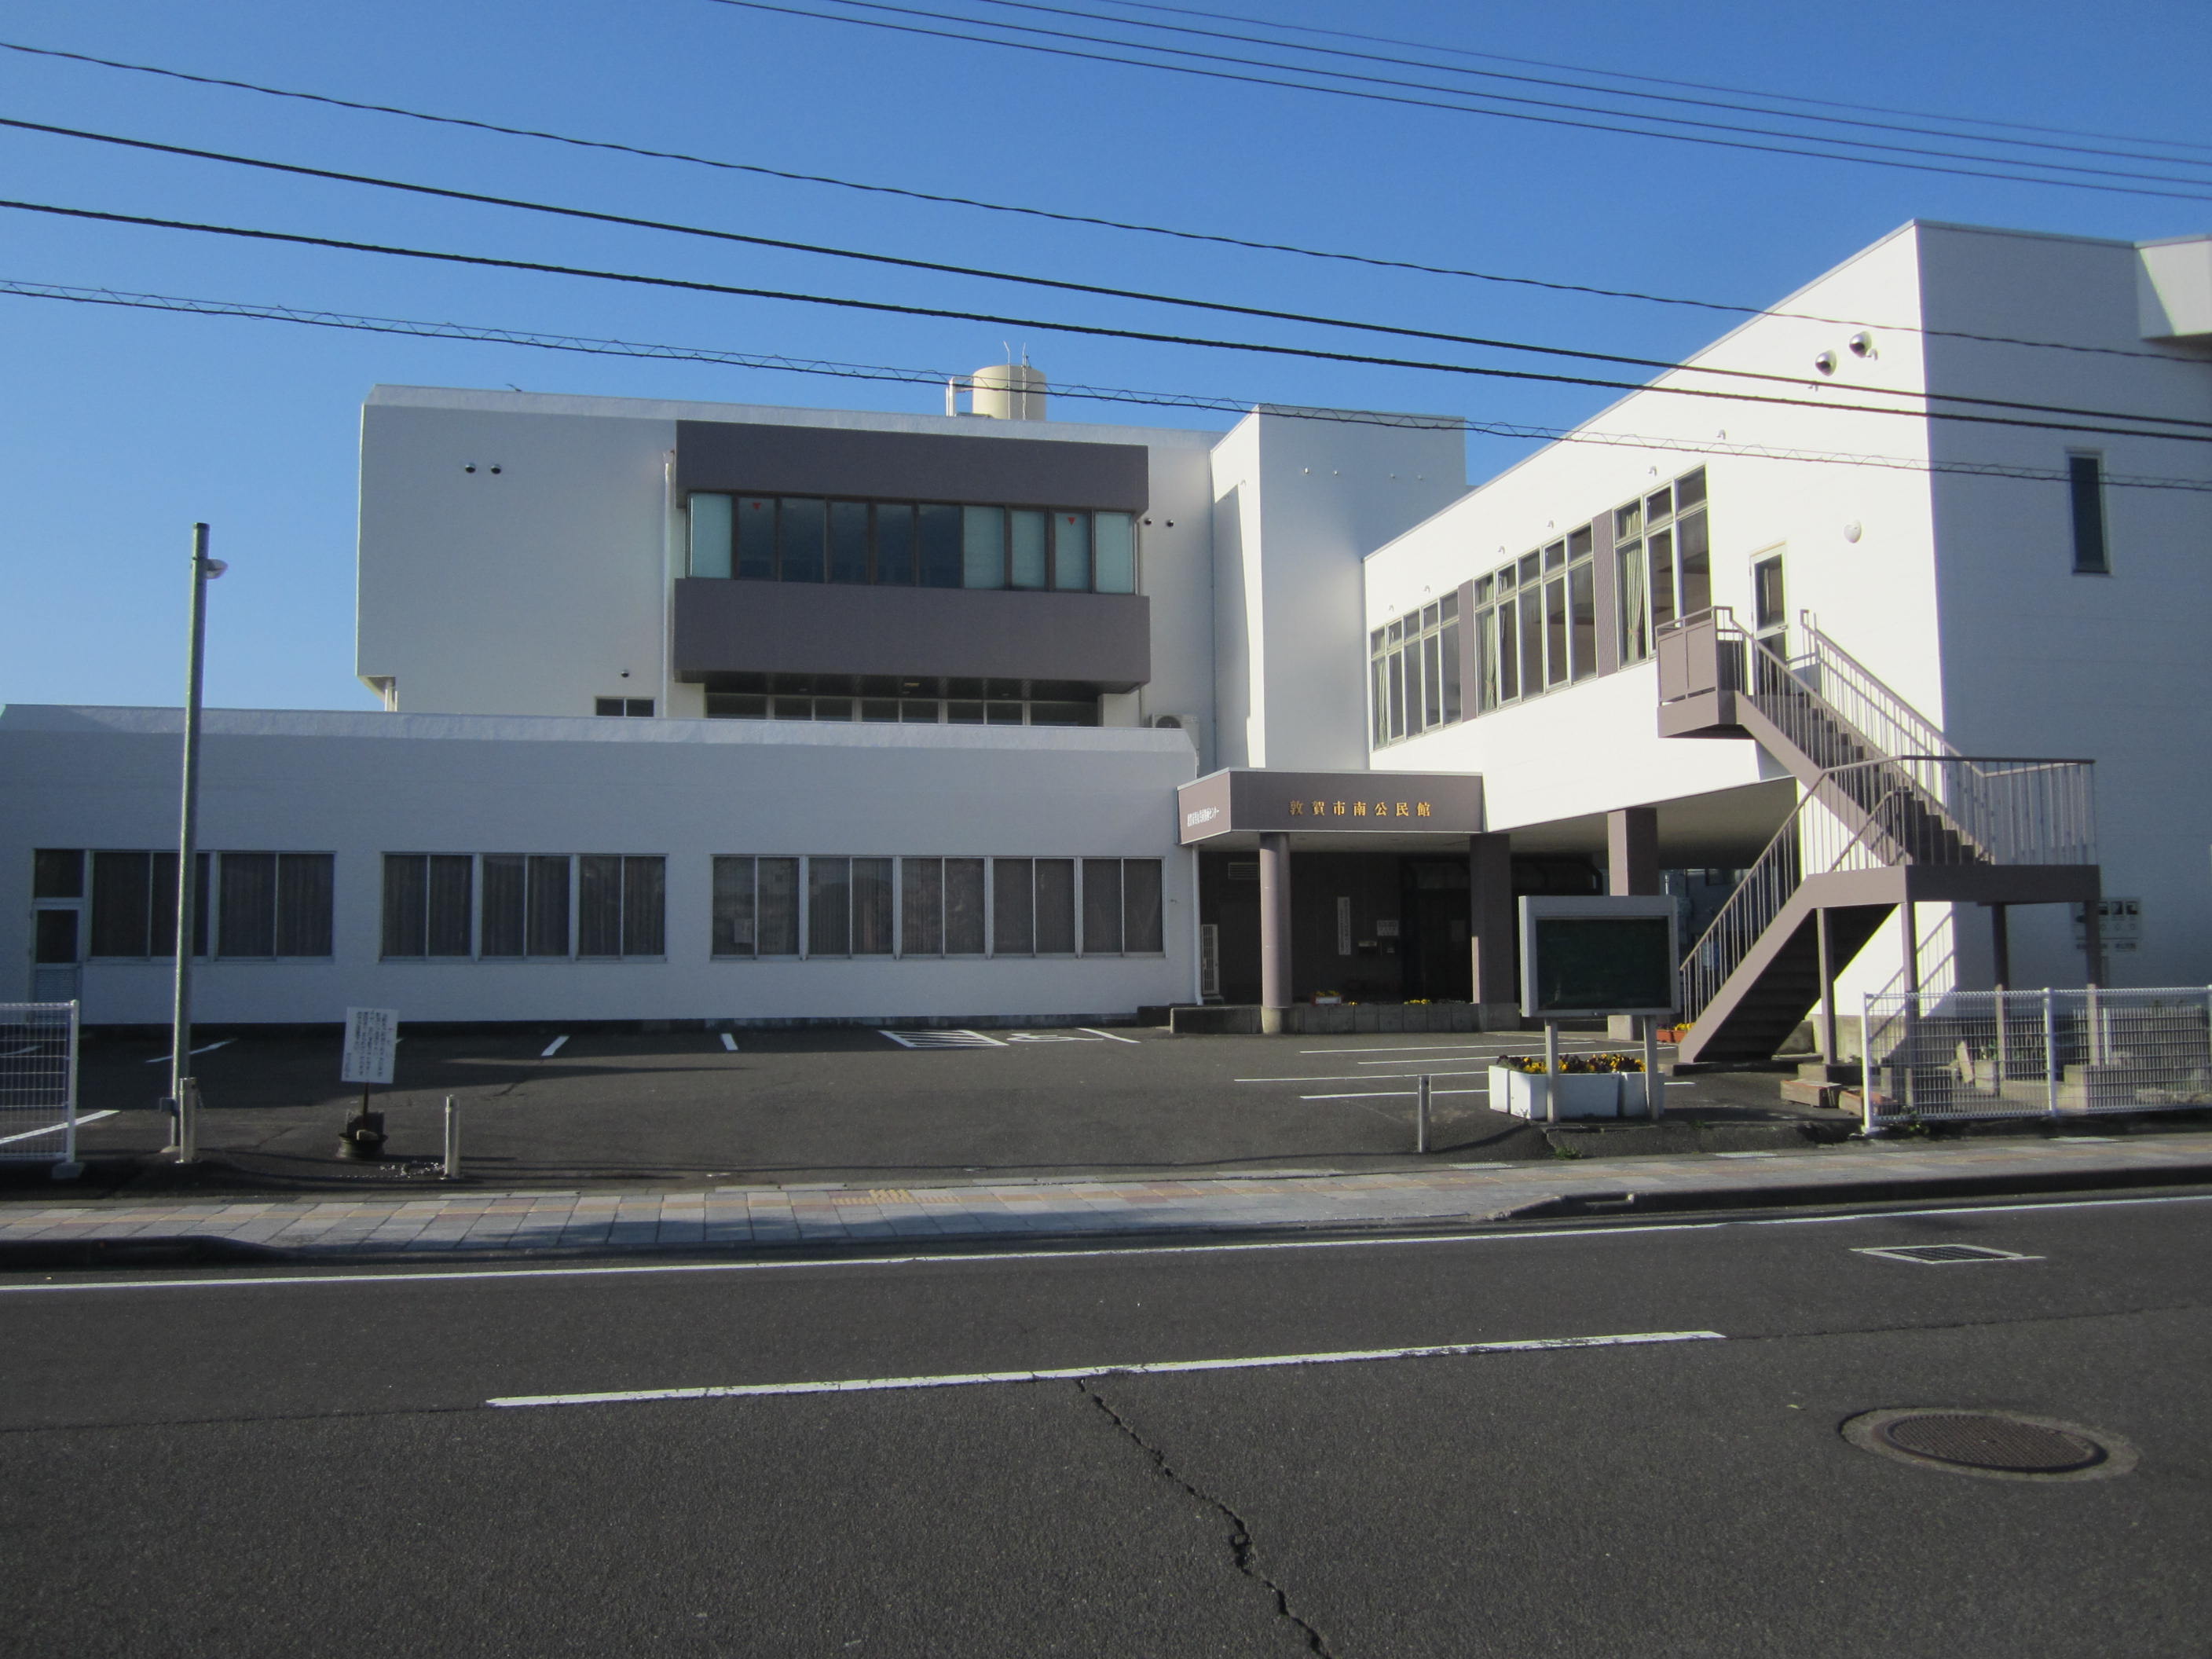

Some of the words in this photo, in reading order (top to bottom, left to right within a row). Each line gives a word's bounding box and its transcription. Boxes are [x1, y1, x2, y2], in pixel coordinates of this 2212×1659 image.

[1289, 800, 1431, 817] 敦賀市南公民館
